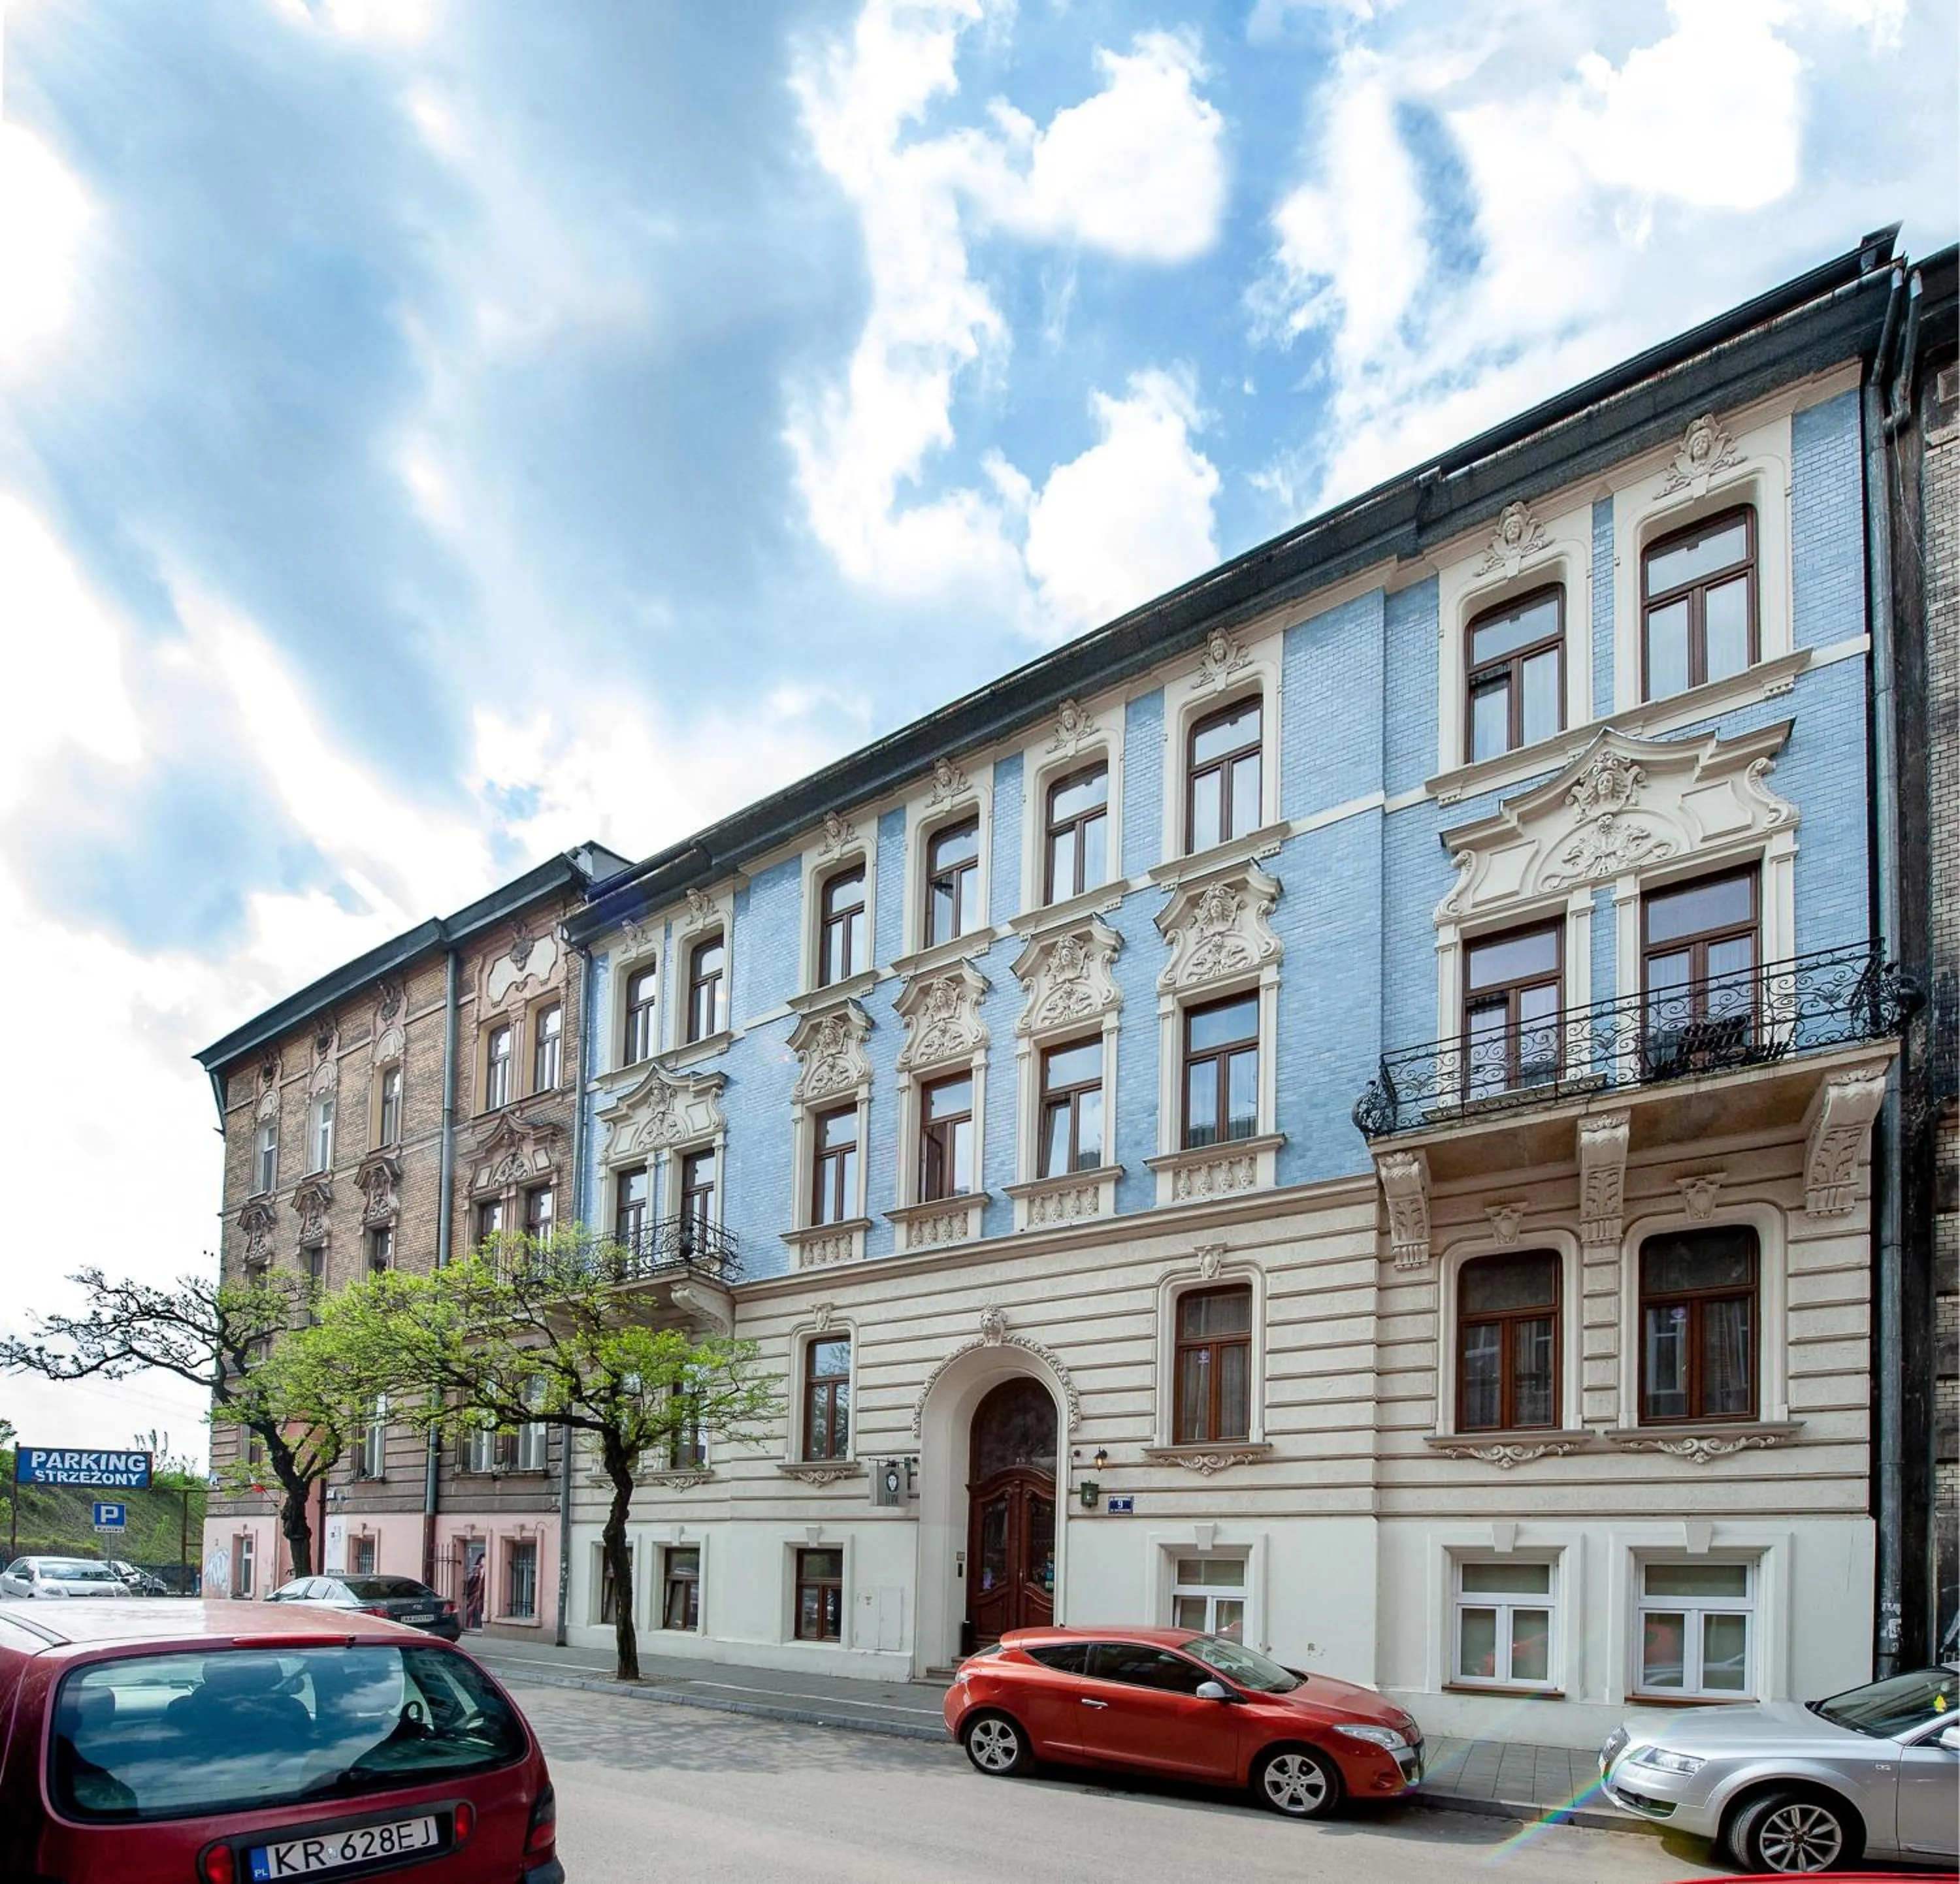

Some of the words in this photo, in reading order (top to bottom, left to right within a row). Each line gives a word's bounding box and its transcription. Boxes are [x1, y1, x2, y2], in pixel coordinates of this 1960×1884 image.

[31, 1451, 146, 1471] PARKING
[101, 1505, 118, 1523] P
[274, 1840, 327, 1875] KR
[340, 1820, 431, 1860] 628EJ
[254, 1868, 269, 1877] PL
